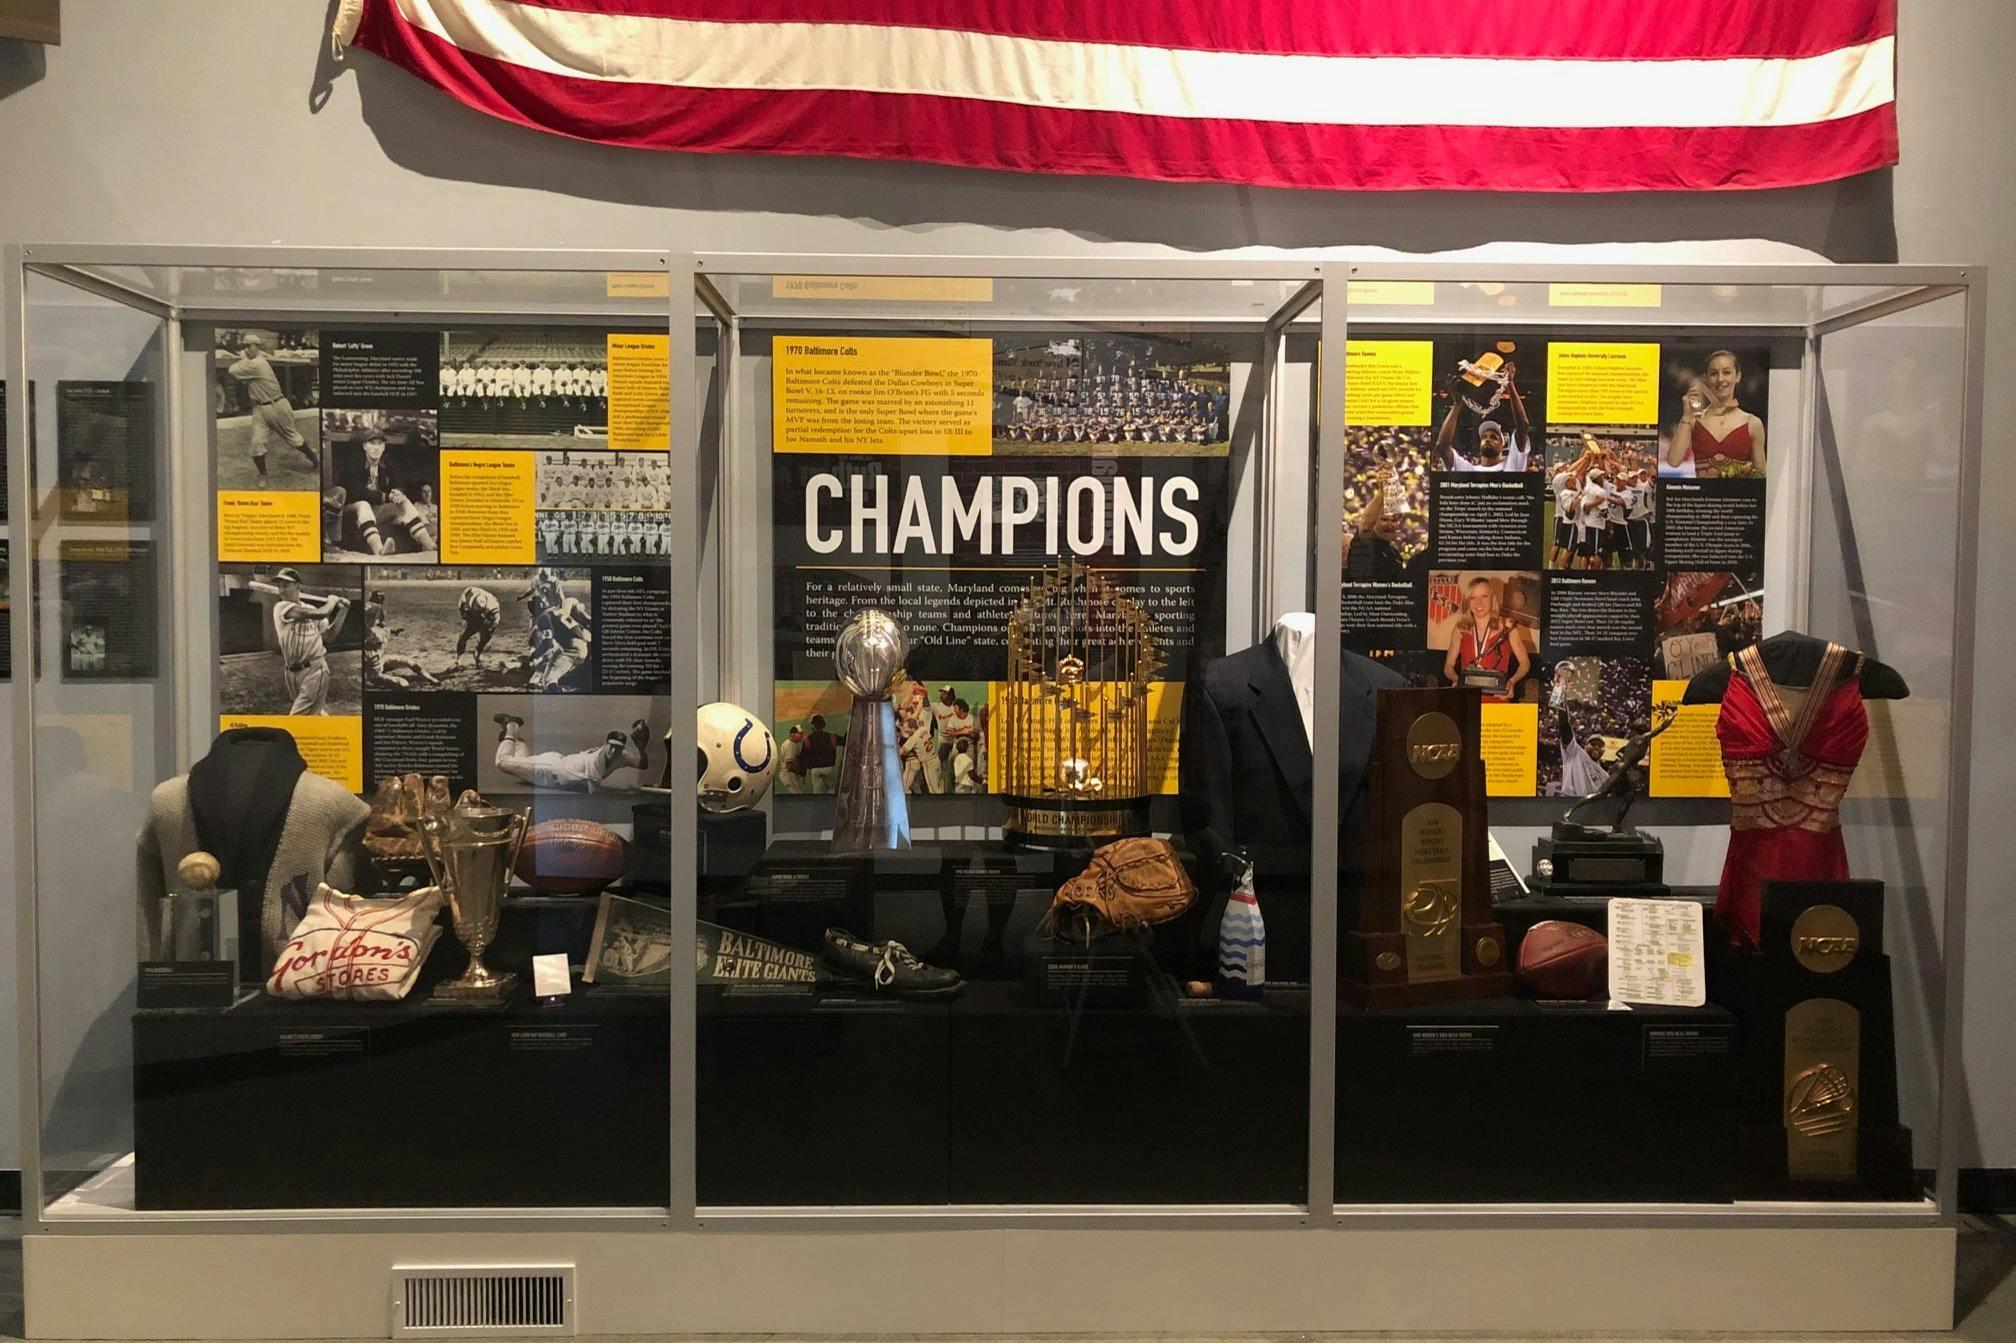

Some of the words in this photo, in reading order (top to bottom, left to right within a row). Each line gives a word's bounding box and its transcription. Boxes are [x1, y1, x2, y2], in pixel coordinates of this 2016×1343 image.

[785, 345, 803, 355] 1970
[804, 346, 838, 355] Baltimore
[839, 346, 858, 356] Colts
[910, 379, 943, 388] Cowboys
[953, 380, 976, 388] Super
[956, 389, 985, 397] seconds
[825, 397, 839, 405] The
[840, 399, 860, 407] game
[924, 399, 965, 408] astonishing
[859, 408, 875, 416] only
[876, 408, 897, 417] Super
[941, 408, 952, 416] the
[953, 409, 977, 418] game's
[785, 416, 804, 424] MVP
[853, 417, 875, 426] losing
[912, 418, 937, 427] victory
[785, 426, 809, 435] partial
[810, 427, 852, 436] redemption
[898, 428, 918, 437] upset
[805, 473, 1199, 556] CHAMPIONS
[806, 583, 822, 591] For
[838, 582, 882, 594] relatively
[886, 583, 912, 592] small
[917, 583, 942, 594] state,
[947, 583, 994, 594] Maryland
[1150, 584, 1161, 593] to
[1165, 584, 1195, 595] sports
[806, 595, 848, 607] heritage.
[851, 596, 877, 604] From
[880, 596, 896, 604] the
[898, 596, 921, 605] local
[924, 596, 961, 607] legends
[963, 596, 1005, 608] depicted
[1148, 597, 1158, 606] to
[1160, 597, 1176, 606] the
[1179, 597, 1194, 606] left
[806, 608, 816, 617] to
[822, 608, 838, 617] the
[918, 609, 947, 618] teams
[953, 609, 971, 618] and
[1154, 610, 1194, 622] sporting
[943, 622, 998, 634] Champions
[1096, 623, 1115, 632] into
[1177, 623, 1195, 632] and
[805, 635, 836, 644] teams
[920, 635, 942, 644] "Old
[945, 635, 971, 644] Line"
[973, 636, 998, 647] state,
[1176, 636, 1194, 645] and
[805, 648, 830, 657] their
[718, 931, 814, 969] BALTIMORE
[273, 936, 411, 993] Gordon's
[763, 962, 816, 982] GIANTS
[316, 968, 389, 992] STORES
